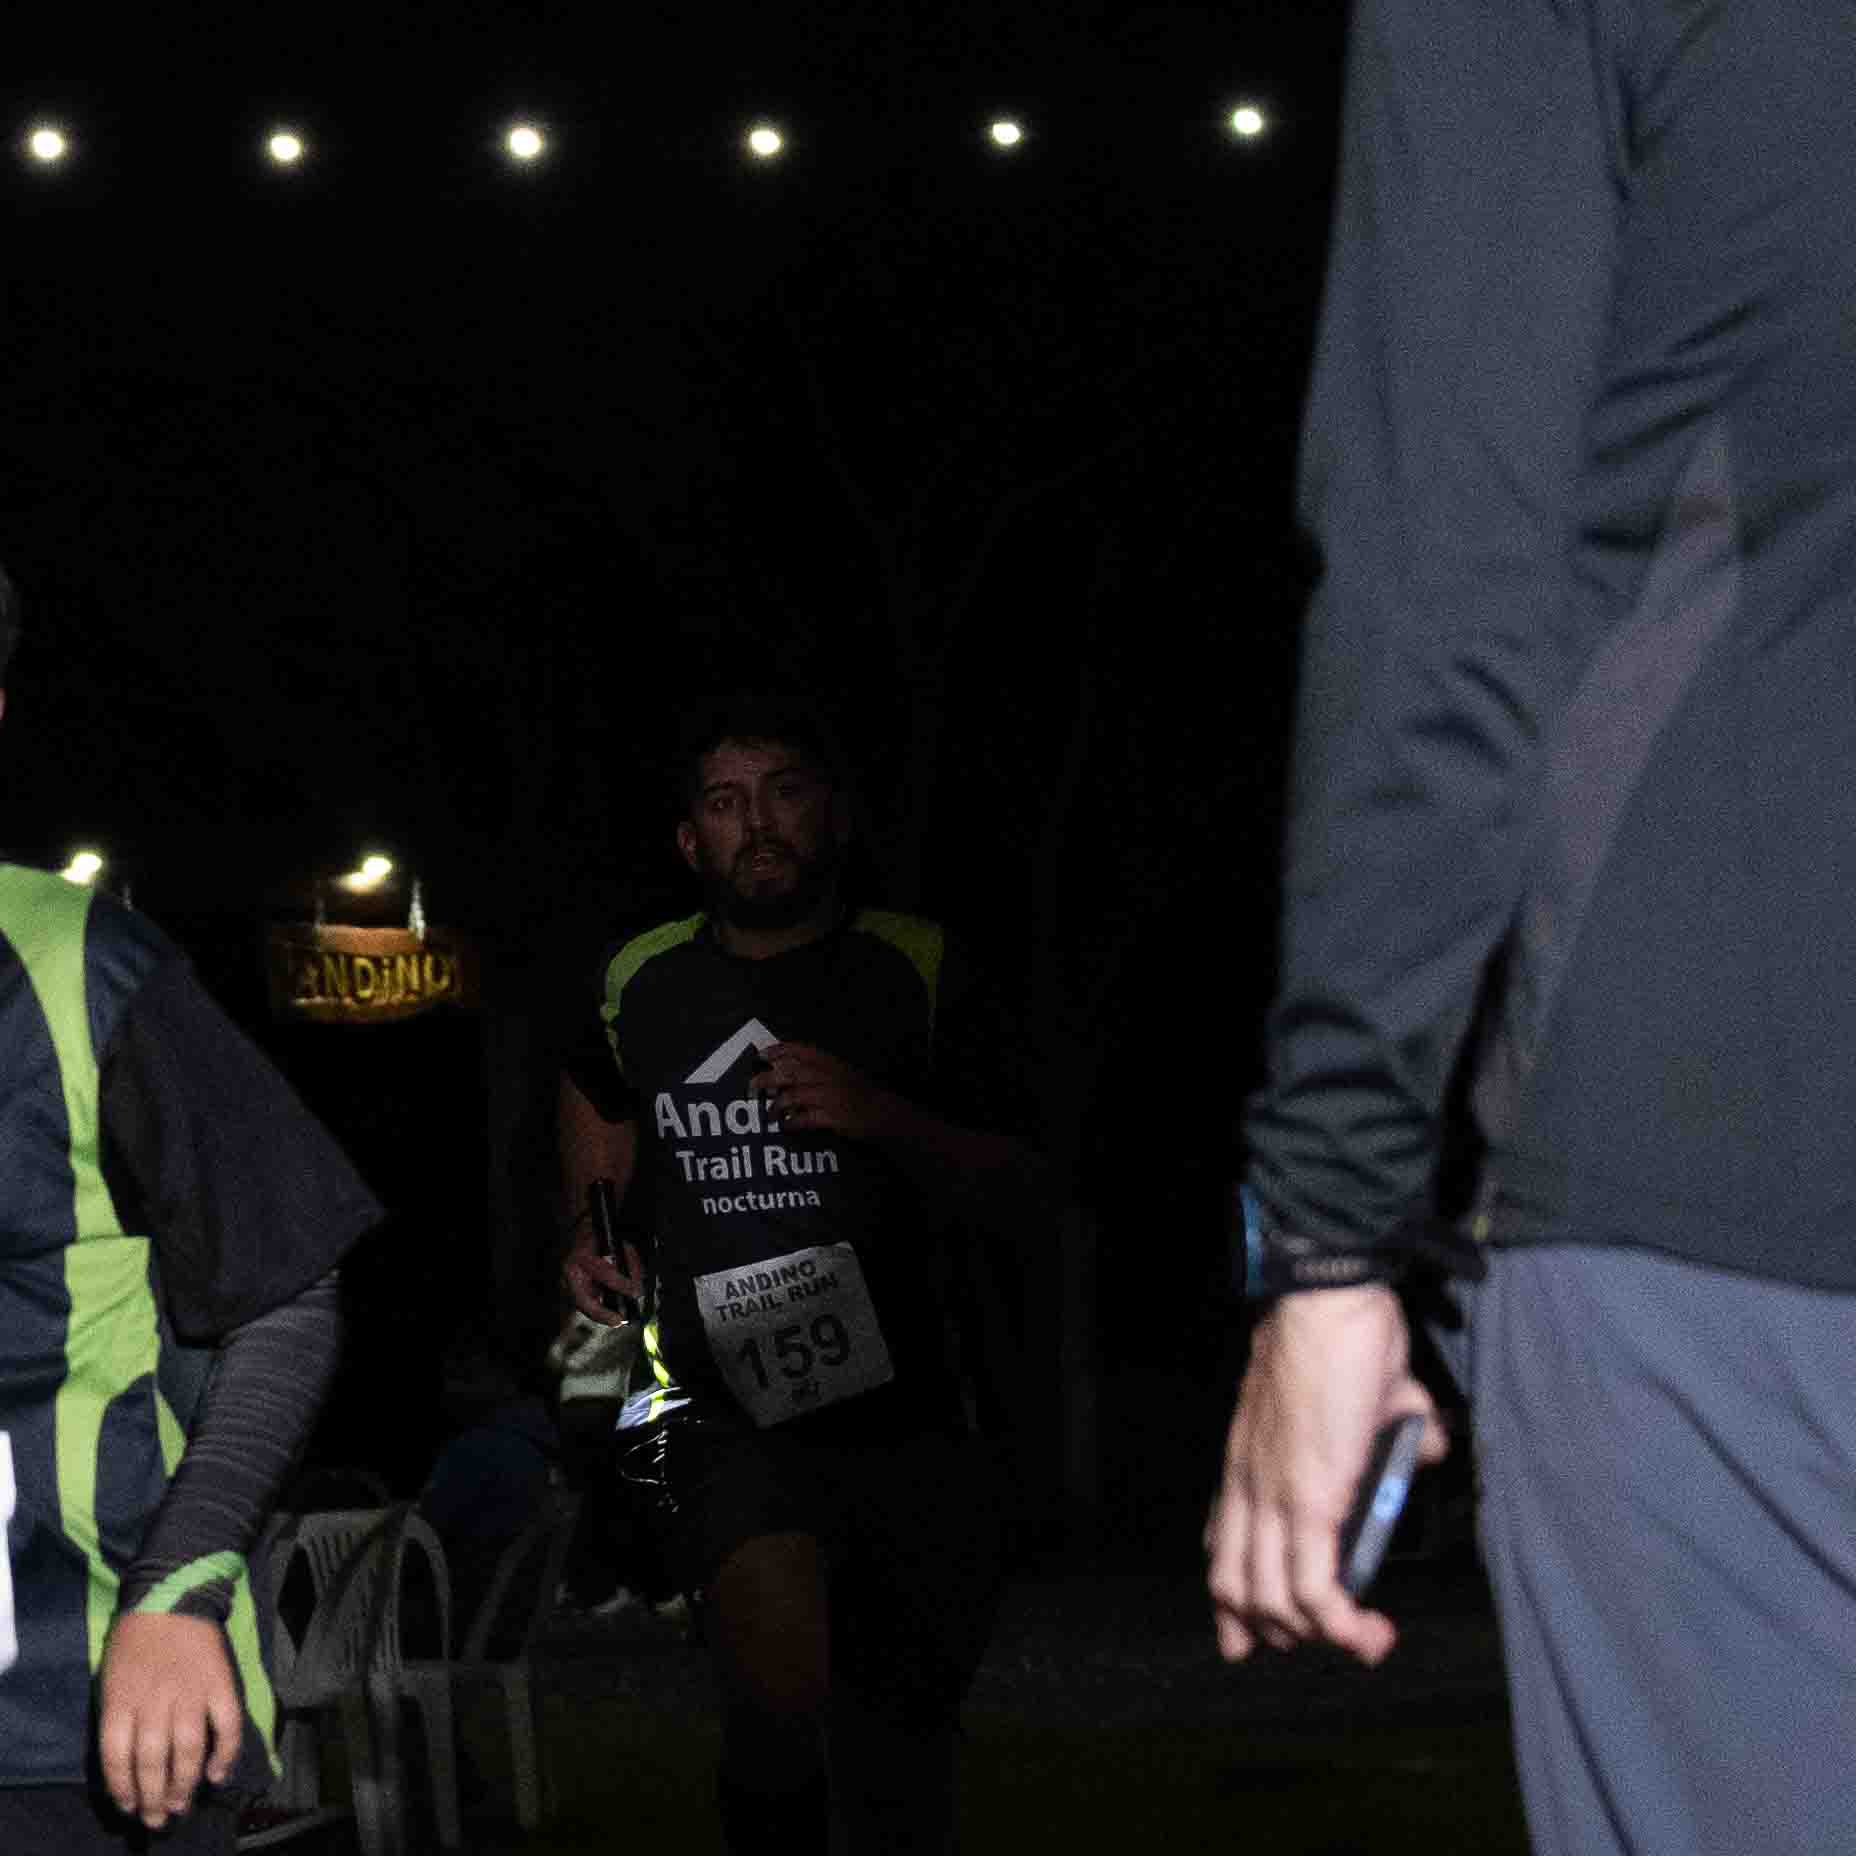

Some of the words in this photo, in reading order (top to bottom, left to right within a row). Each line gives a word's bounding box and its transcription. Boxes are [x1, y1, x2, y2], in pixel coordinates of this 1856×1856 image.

[675, 1145, 753, 1183] Trail
[762, 1145, 841, 1176] Run
[702, 1189, 824, 1216] nocturna
[724, 1260, 817, 1300] ANDINO
[715, 1293, 784, 1322] TRAIL
[741, 1314, 849, 1387] 159
